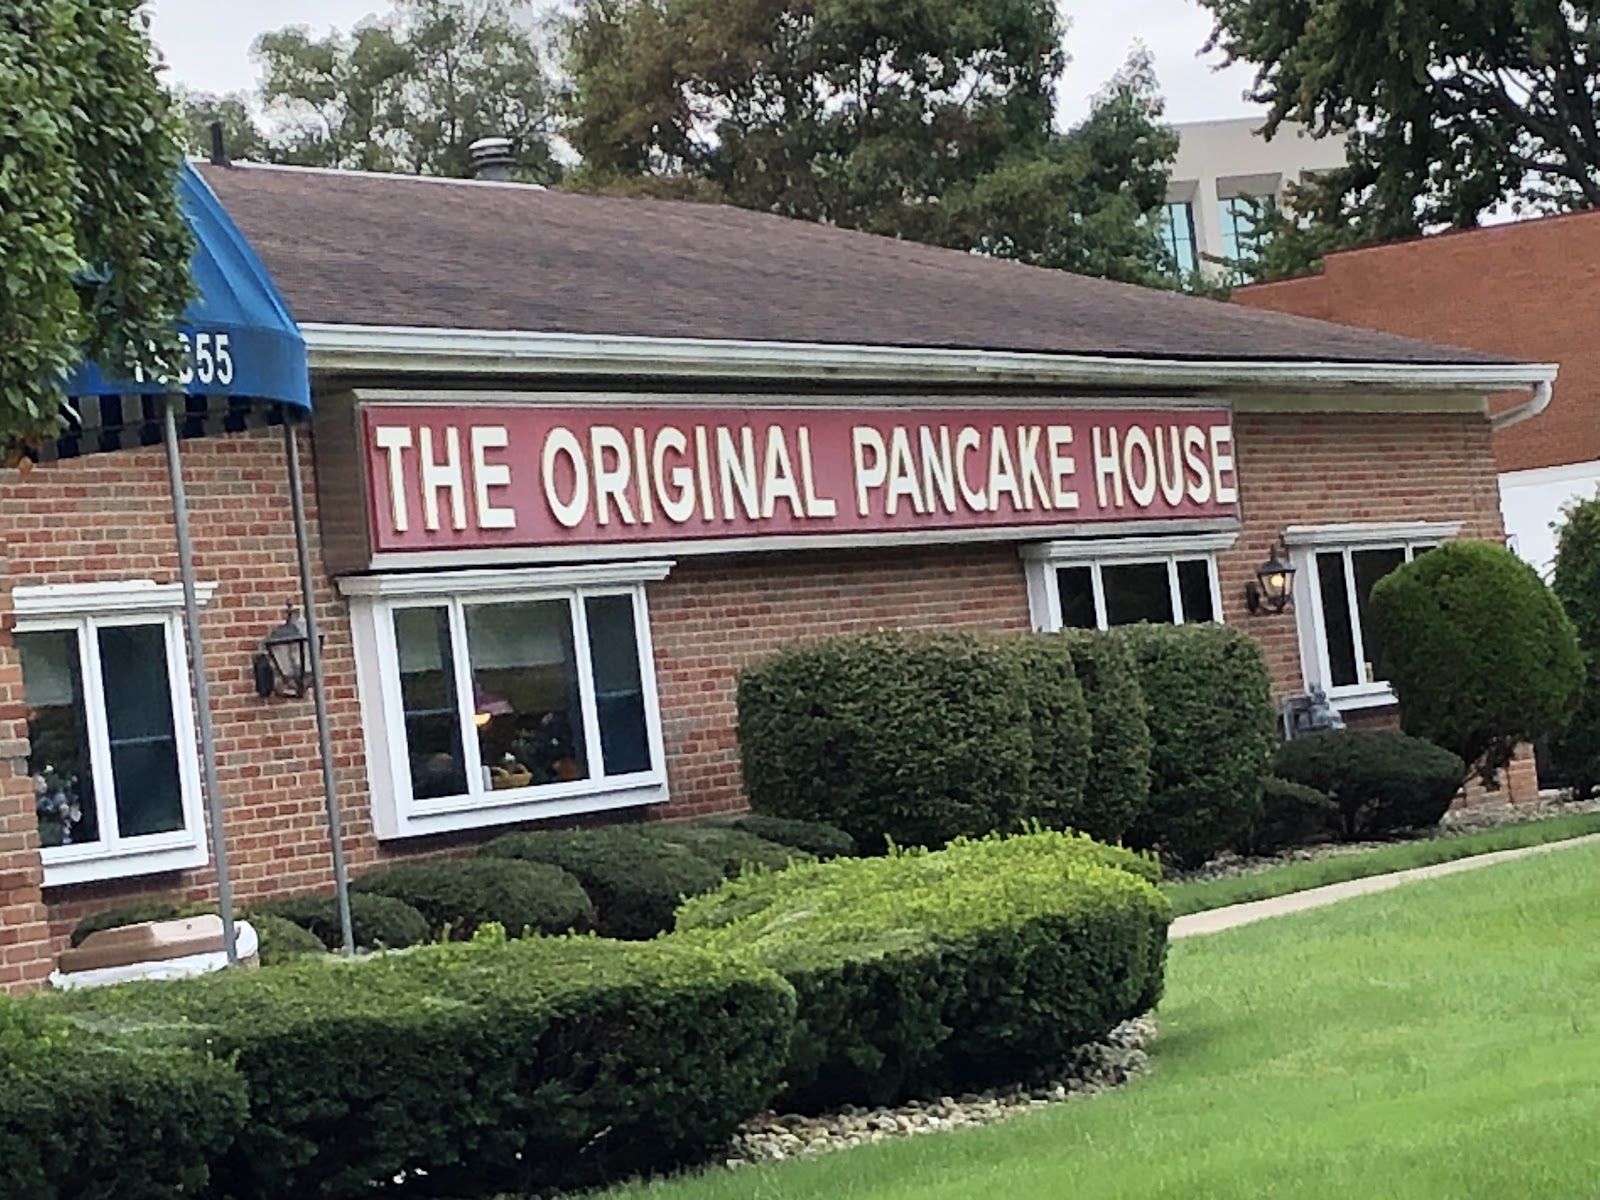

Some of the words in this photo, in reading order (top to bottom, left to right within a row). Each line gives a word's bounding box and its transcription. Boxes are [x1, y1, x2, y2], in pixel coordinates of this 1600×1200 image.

[376, 425, 516, 532] THE
[542, 425, 836, 528] ORIGINAL
[852, 426, 1079, 516] PANCAKE
[1093, 425, 1237, 508] HOUSE
